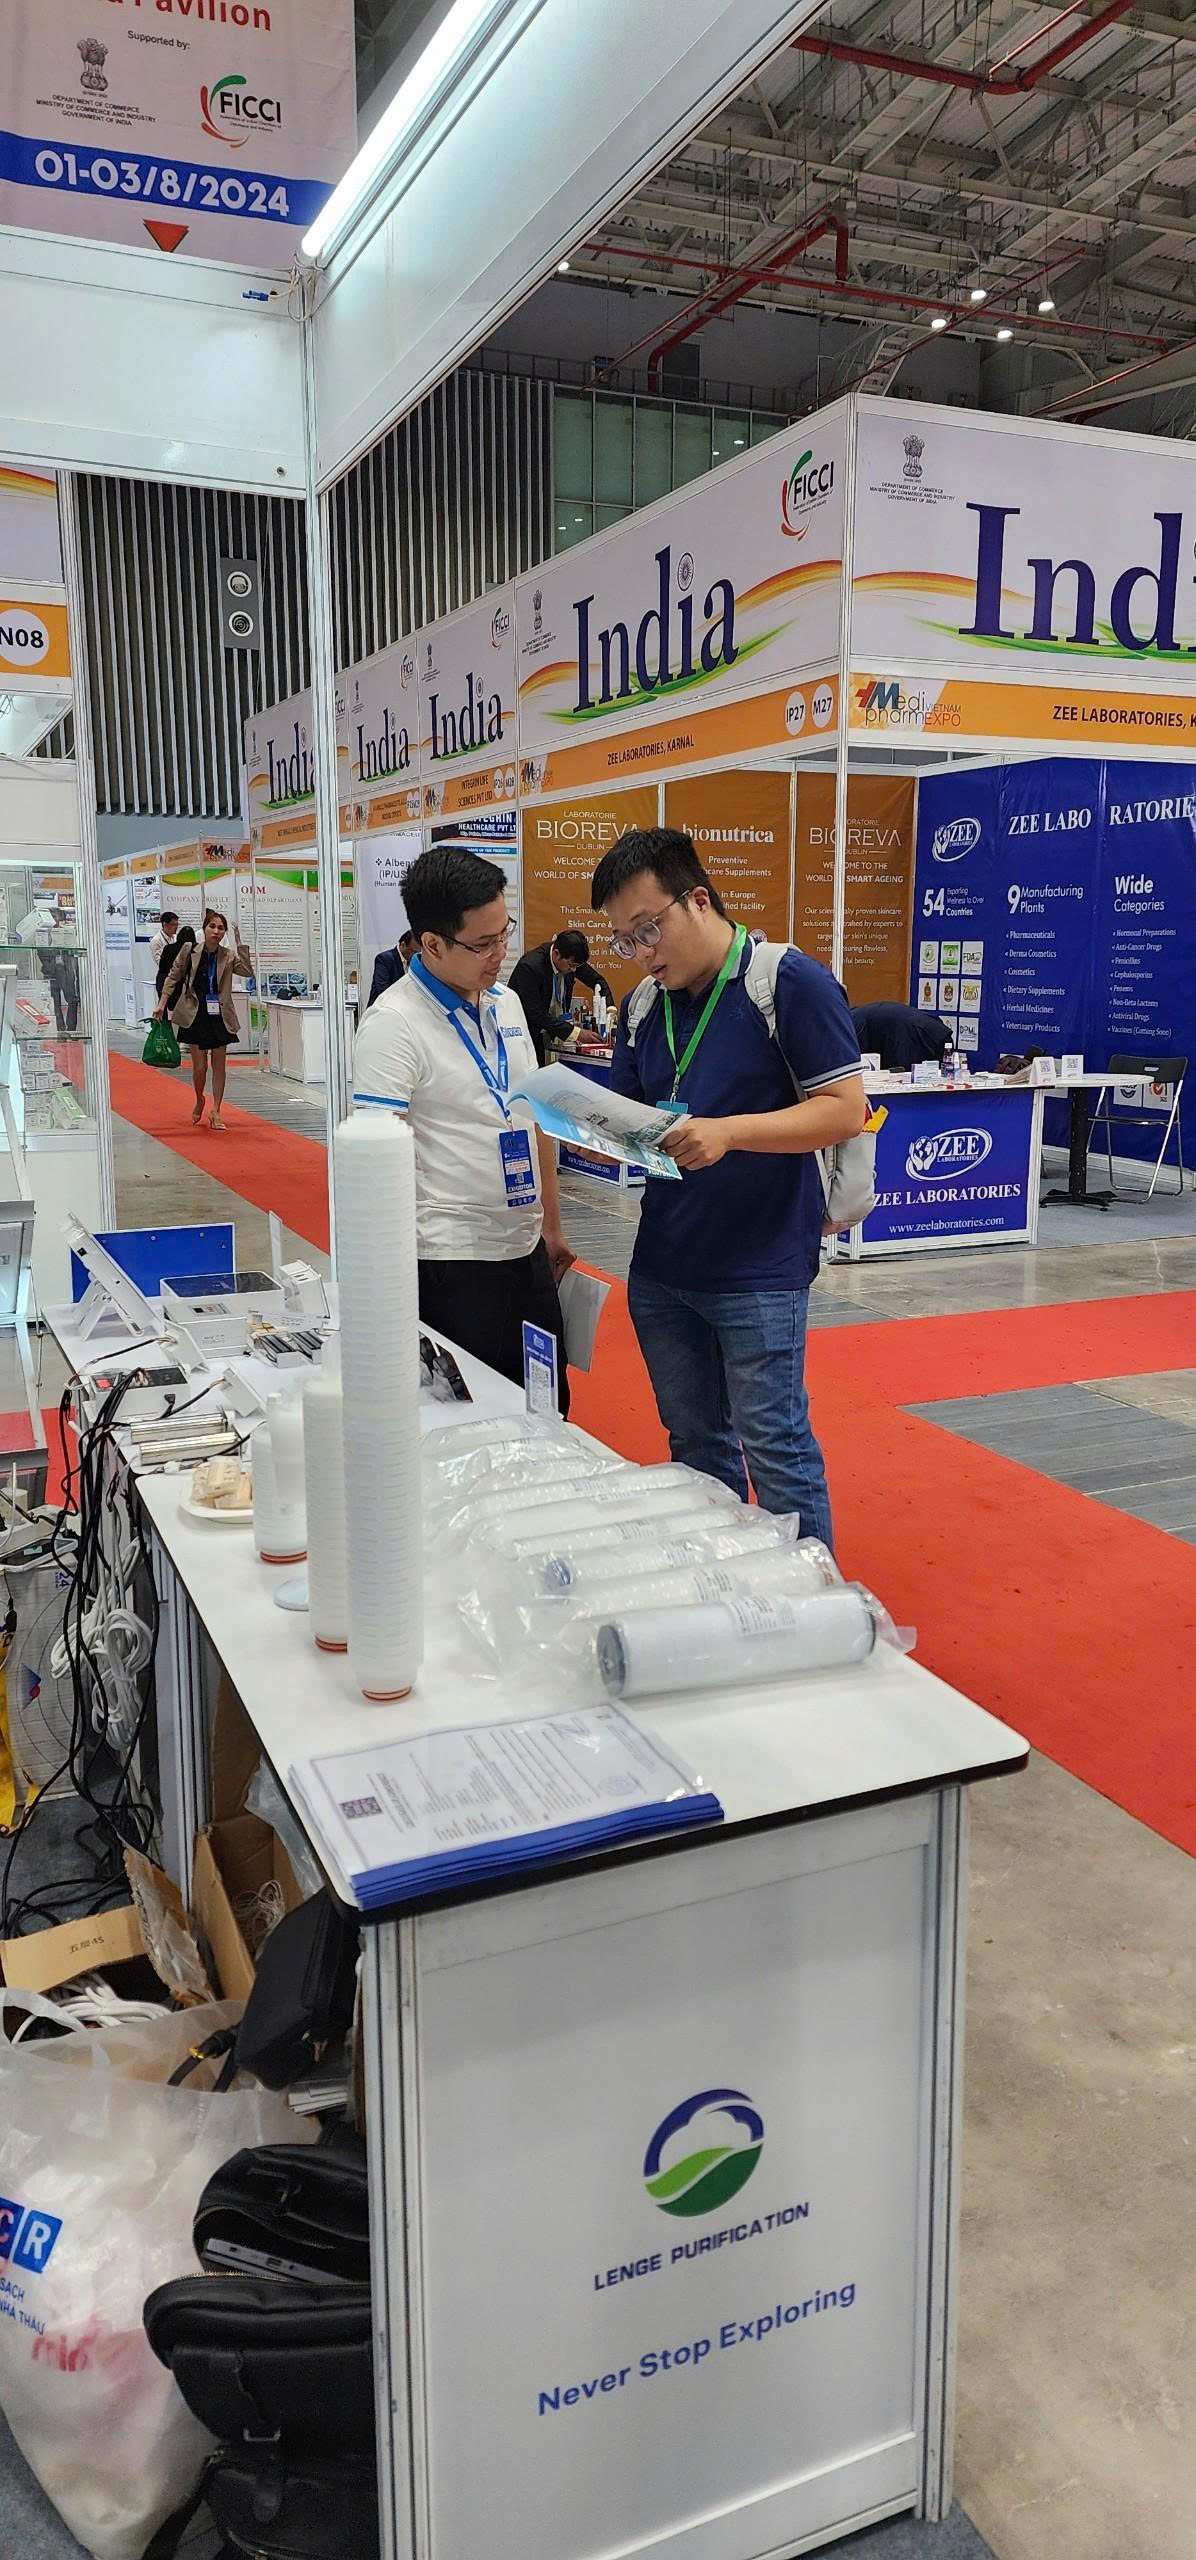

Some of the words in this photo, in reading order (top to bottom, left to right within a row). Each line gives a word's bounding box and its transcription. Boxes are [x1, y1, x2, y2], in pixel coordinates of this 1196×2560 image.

[127, 30, 175, 47] Supported
[176, 37, 191, 50] by:
[52, 94, 94, 106] DEPARTMENT
[104, 103, 140, 113] COMMERCE
[220, 91, 281, 123] FICCI
[76, 104, 111, 115] COMMERCE
[62, 110, 105, 121] GOVERNMENT
[35, 150, 289, 217] 01-03/8/2024
[794, 461, 834, 505] FICCI
[958, 502, 1196, 652] Ind
[495, 614, 509, 633] FICCI
[572, 544, 739, 714] India
[813, 696, 832, 716] M27
[428, 672, 504, 761] India
[786, 704, 805, 723] IP27
[1053, 705, 1080, 721] ZEE
[1082, 707, 1187, 730] LABORATORIES,
[356, 706, 411, 782] India
[607, 752, 618, 766] ZEE
[619, 742, 665, 764] LABORATORIES,
[667, 734, 694, 751] KARNAL
[563, 810, 617, 819] LABORATORIE
[1109, 796, 1196, 826] RATORIE
[458, 823, 496, 831] HEALTHCARE
[1007, 813, 1040, 835] ZEE
[1044, 808, 1092, 832] LABO
[682, 823, 775, 843] bionutrica
[950, 823, 974, 842] ZEE
[385, 858, 416, 867] Albend
[553, 856, 596, 866] WELCOME
[708, 855, 749, 865] Preventive
[861, 861, 872, 870] TO
[873, 862, 888, 870] THE
[380, 869, 408, 881] (IP/US
[534, 870, 566, 879] WORLD
[568, 872, 579, 880] OF
[581, 872, 594, 880] SM
[724, 867, 772, 877] Supplements
[805, 874, 833, 882] WORLD
[846, 875, 873, 883] SMART
[874, 875, 904, 883] AGEING
[1114, 873, 1154, 895] Wide
[730, 890, 756, 899] Europe
[1020, 883, 1084, 899] Manufacturing
[922, 887, 945, 917] 54
[1007, 884, 1021, 914] 9
[560, 905, 575, 914] The
[740, 902, 765, 911] facility
[804, 906, 817, 914] Our
[855, 908, 877, 916] proven
[878, 906, 902, 914] skincare
[1020, 900, 1045, 913] Plants
[1113, 897, 1165, 914] Categories
[945, 907, 974, 917] Countries
[568, 919, 585, 928] Skin
[587, 919, 606, 928] Care
[864, 920, 872, 928] by
[596, 934, 615, 942] Prod
[817, 933, 833, 941] targe
[1009, 930, 1056, 939] Pharmaceuticals
[1116, 929, 1142, 937] Hormonal
[1142, 928, 1176, 938] Preparations
[1115, 943, 1146, 951] Anti-Cancer
[1146, 943, 1162, 952] Drugs
[1009, 949, 1027, 958] Derma
[1028, 949, 1057, 958] Cosmetics
[596, 961, 607, 969] for
[1008, 967, 1036, 976] Cosmetics
[1007, 985, 1028, 996] Dietary
[1028, 985, 1066, 996] Supplements
[1112, 998, 1136, 1006] Non-Beta
[1006, 1003, 1025, 1012] Herbal
[1025, 1004, 1054, 1014] Medicines
[1112, 1012, 1134, 1020] Antiviral
[1134, 1012, 1150, 1022] Drugs
[1005, 1021, 1034, 1032] Veterinary
[1034, 1022, 1061, 1033] Products
[937, 1134, 980, 1157] ZEE
[936, 1154, 979, 1163] LABORATORIES
[873, 1191, 902, 1207] ZEE
[906, 1183, 1021, 1205] LABORATORIES
[888, 1216, 1005, 1233] www.zeelaboratories.com
[593, 2254, 662, 2292] LENGE
[670, 2202, 810, 2265] PURIFICATION
[537, 2367, 631, 2416] Never
[638, 2338, 711, 2378] Stop
[718, 2283, 857, 2349] Exploring
